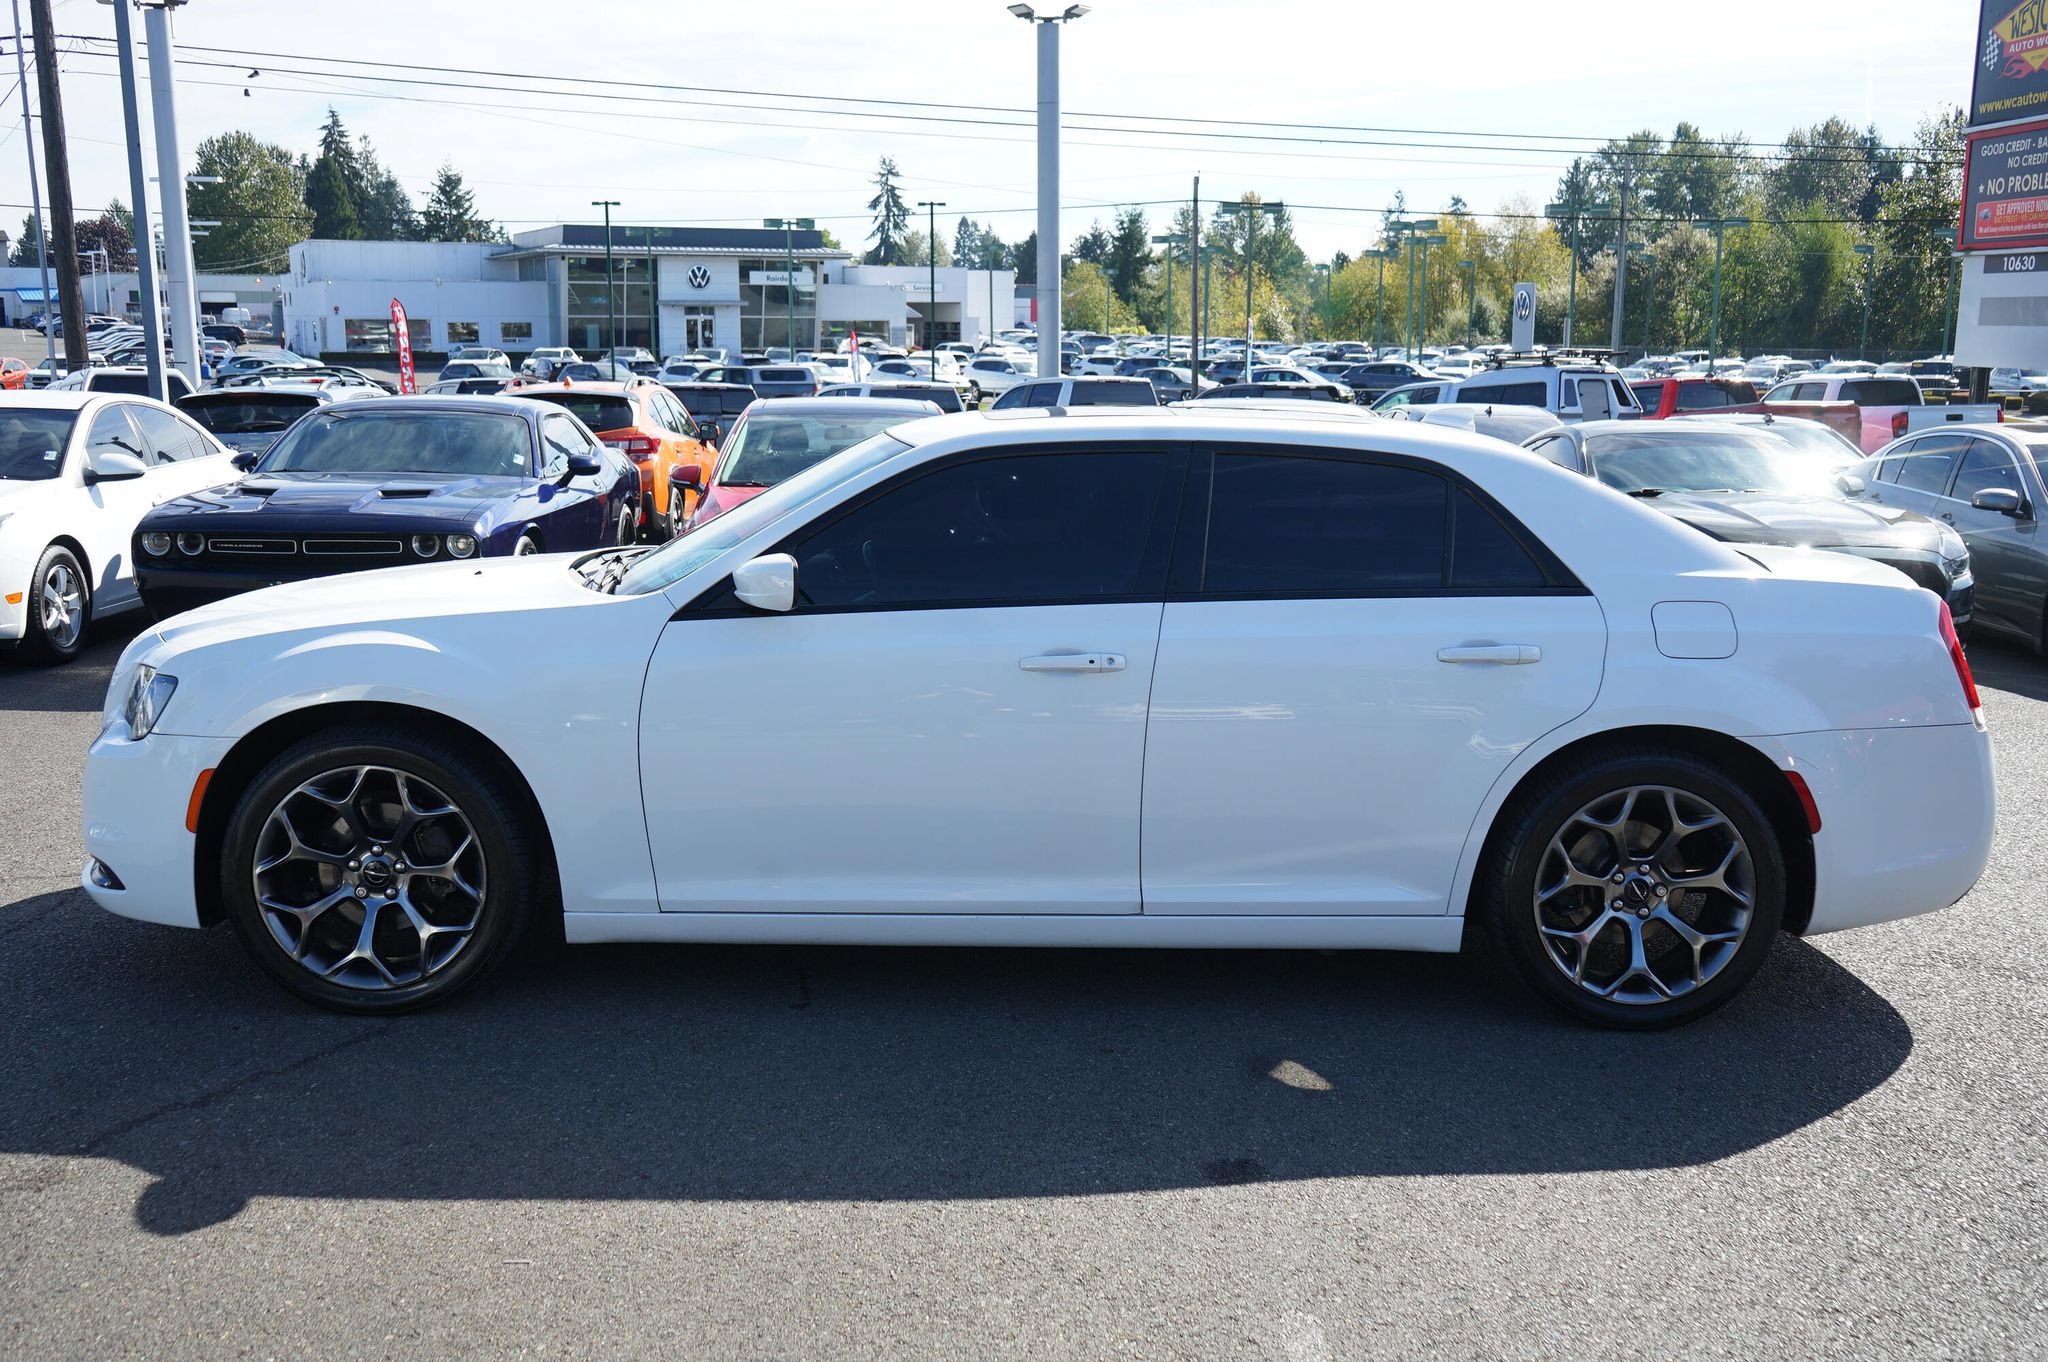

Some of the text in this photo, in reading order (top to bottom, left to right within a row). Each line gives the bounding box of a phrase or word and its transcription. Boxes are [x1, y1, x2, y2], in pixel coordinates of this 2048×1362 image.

[2009, 39, 2034, 53] AUTO
[1981, 143, 2005, 157] GOOD
[2005, 138, 2032, 153] CREDIT
[2007, 152, 2048, 168] NO CREDIT
[1987, 171, 2048, 195] NO PROBLE
[2006, 201, 2035, 214] APPROVED
[2002, 255, 2036, 271] 10630
